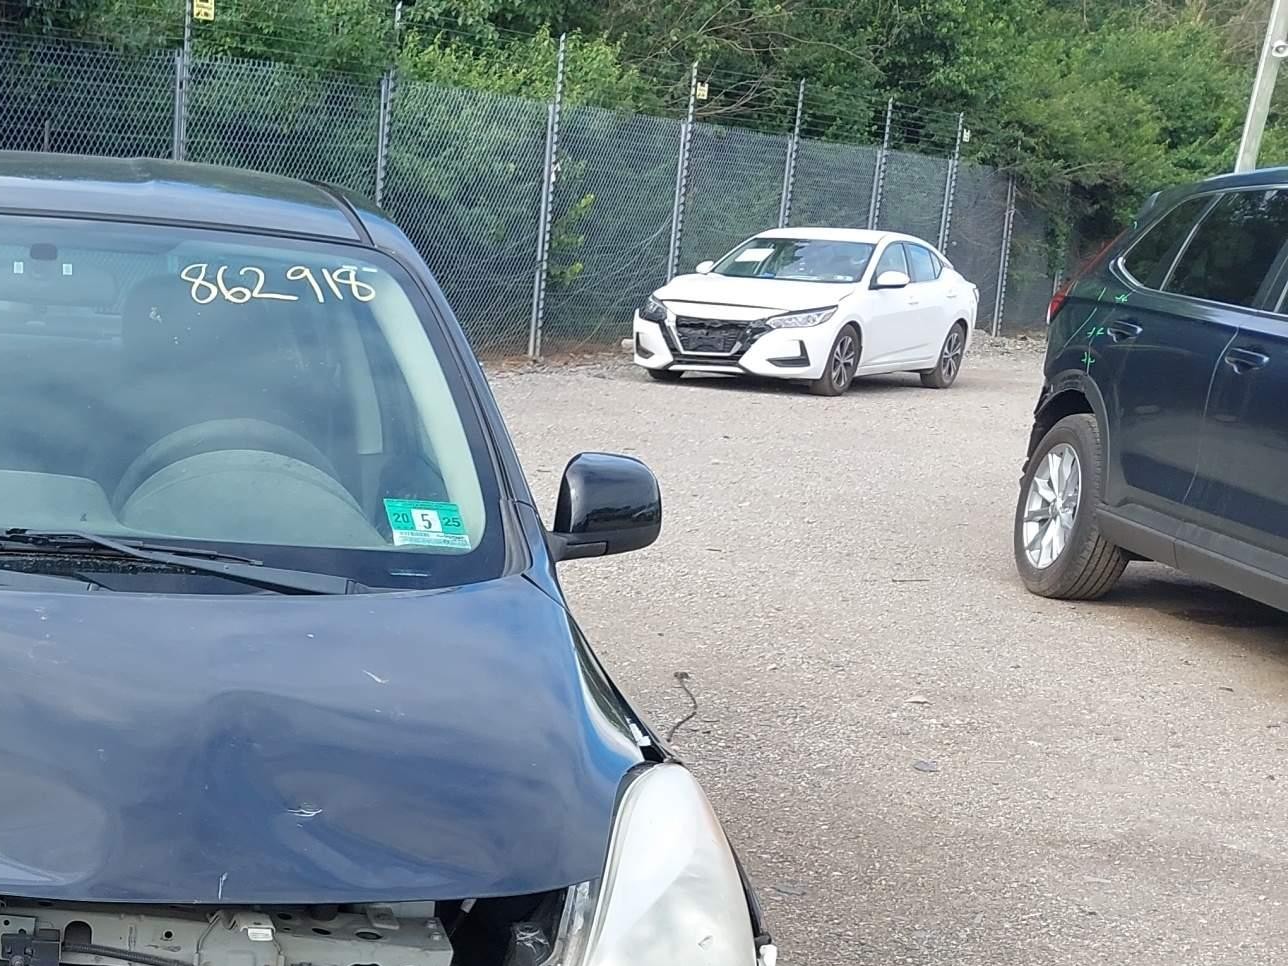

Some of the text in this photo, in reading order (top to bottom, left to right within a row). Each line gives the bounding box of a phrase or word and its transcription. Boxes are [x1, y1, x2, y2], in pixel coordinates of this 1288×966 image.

[392, 512, 461, 530] 20 5 25
